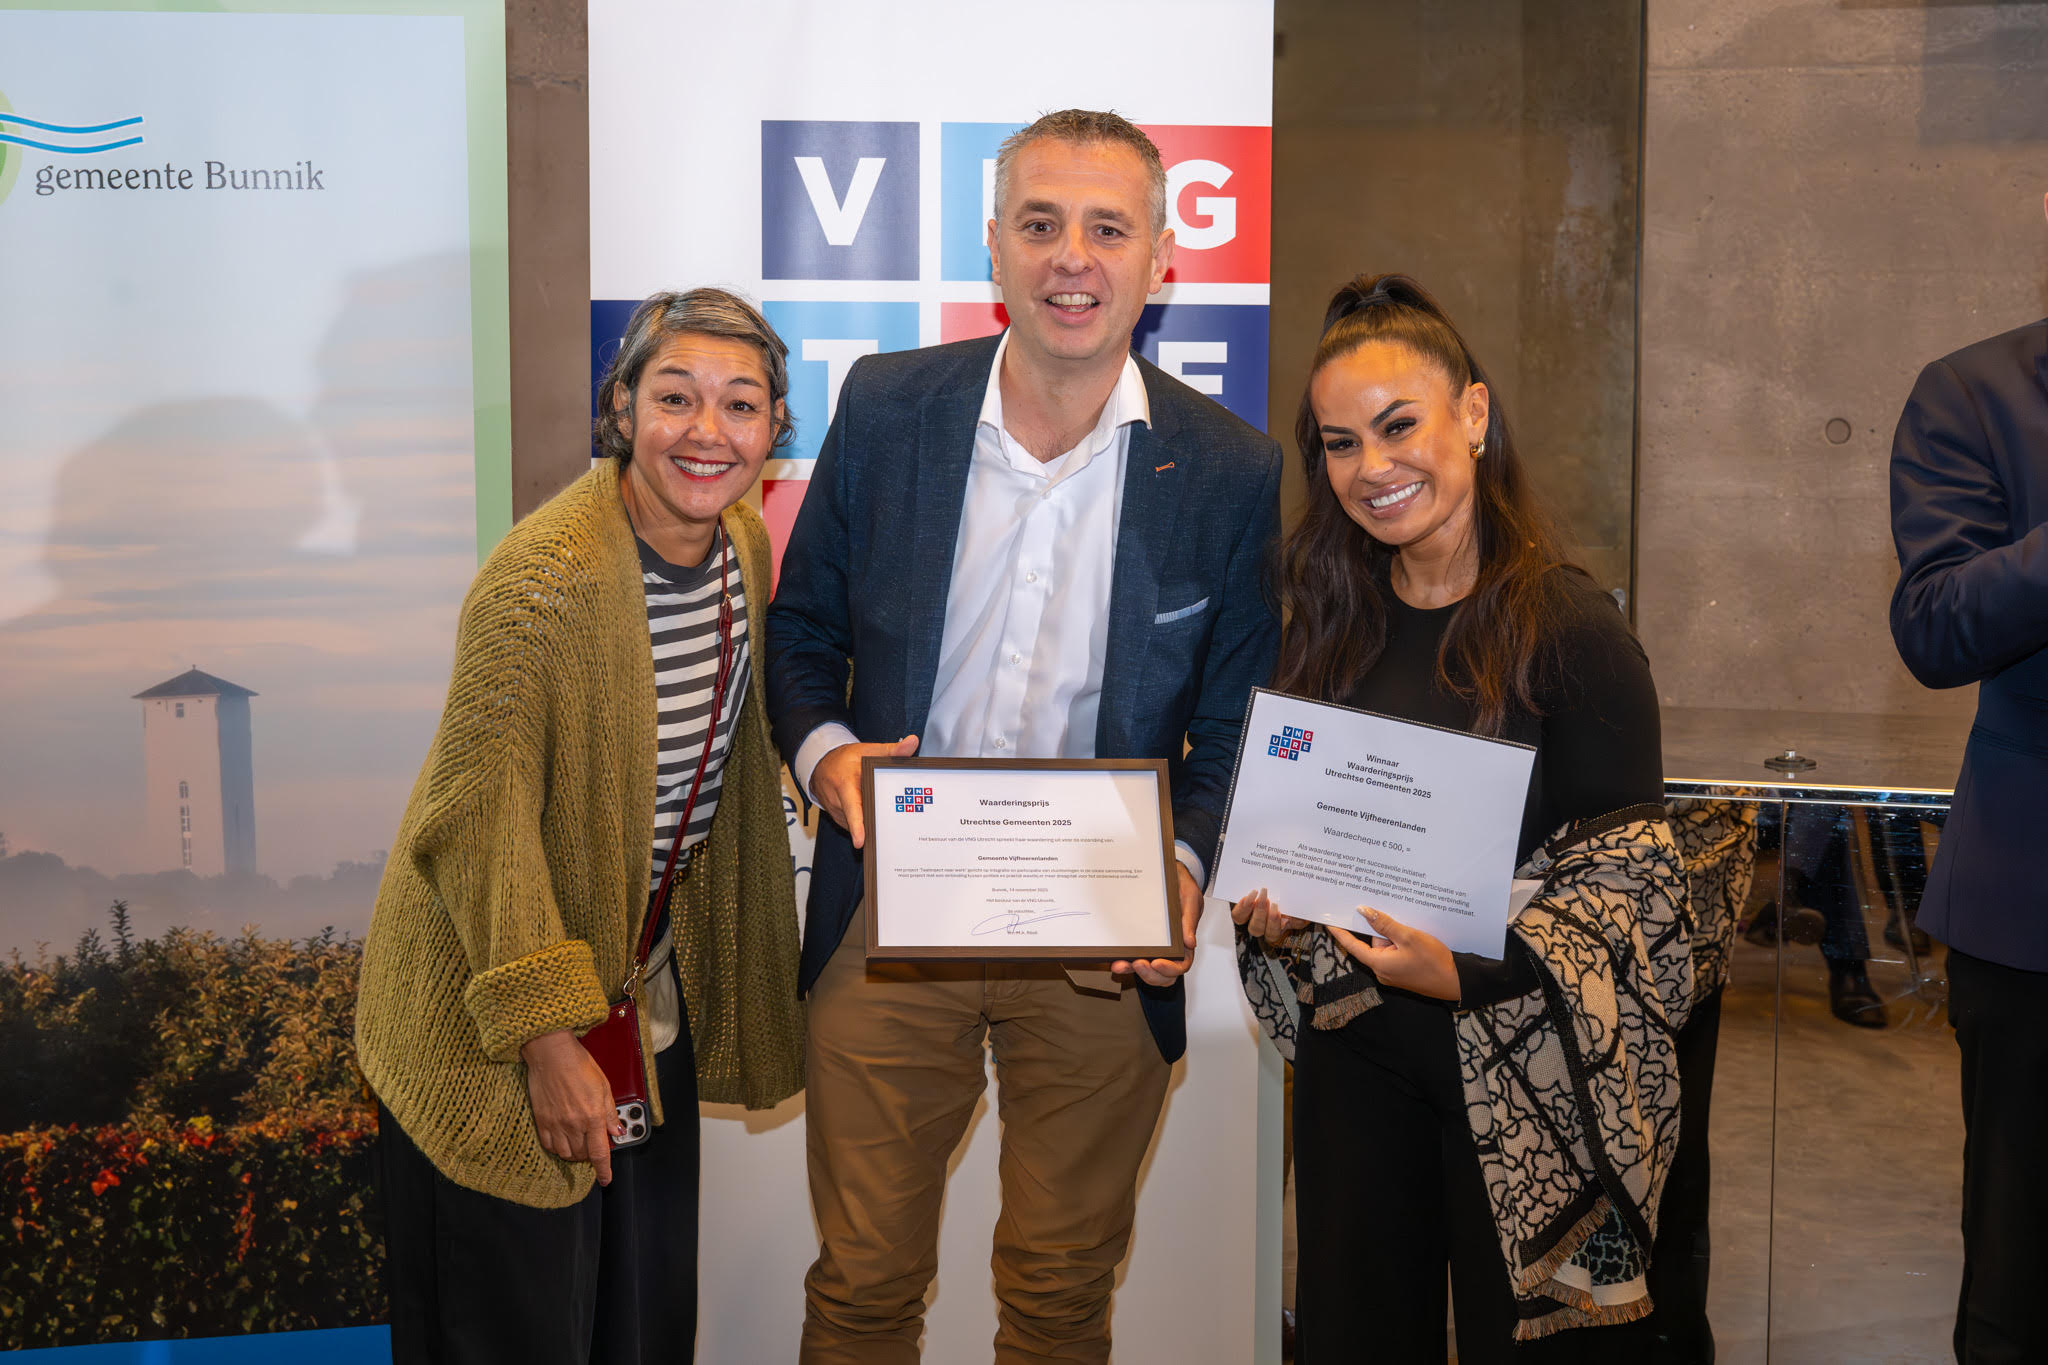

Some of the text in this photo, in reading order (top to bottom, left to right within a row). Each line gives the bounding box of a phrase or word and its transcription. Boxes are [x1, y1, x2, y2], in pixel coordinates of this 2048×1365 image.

[35, 161, 325, 196] gemeente Bunnik
[794, 156, 1236, 250] VG
[1285, 727, 1311, 739] VNG
[1272, 737, 1309, 750] UTRE
[1270, 748, 1296, 758] CHT
[1365, 754, 1400, 767] Winnaar
[1346, 761, 1414, 784] Waarderingsprijs
[1324, 767, 1432, 798] Utrechtse Gemeenten 2025
[980, 799, 1049, 807] Waarderingsprijs
[960, 818, 1001, 826] Utrechtse
[1316, 800, 1426, 833] Gemeente Vijfheerenlanden
[1322, 826, 1381, 847] Waardecheque
[1256, 842, 1267, 850] Het
[1267, 845, 1288, 855] project
[1308, 845, 1341, 859] waardering
[1366, 859, 1401, 872] succesvolle
[1364, 876, 1375, 884] Een
[1376, 879, 1391, 888] mooi
[1391, 883, 1412, 894] project
[1390, 892, 1403, 900] voor
